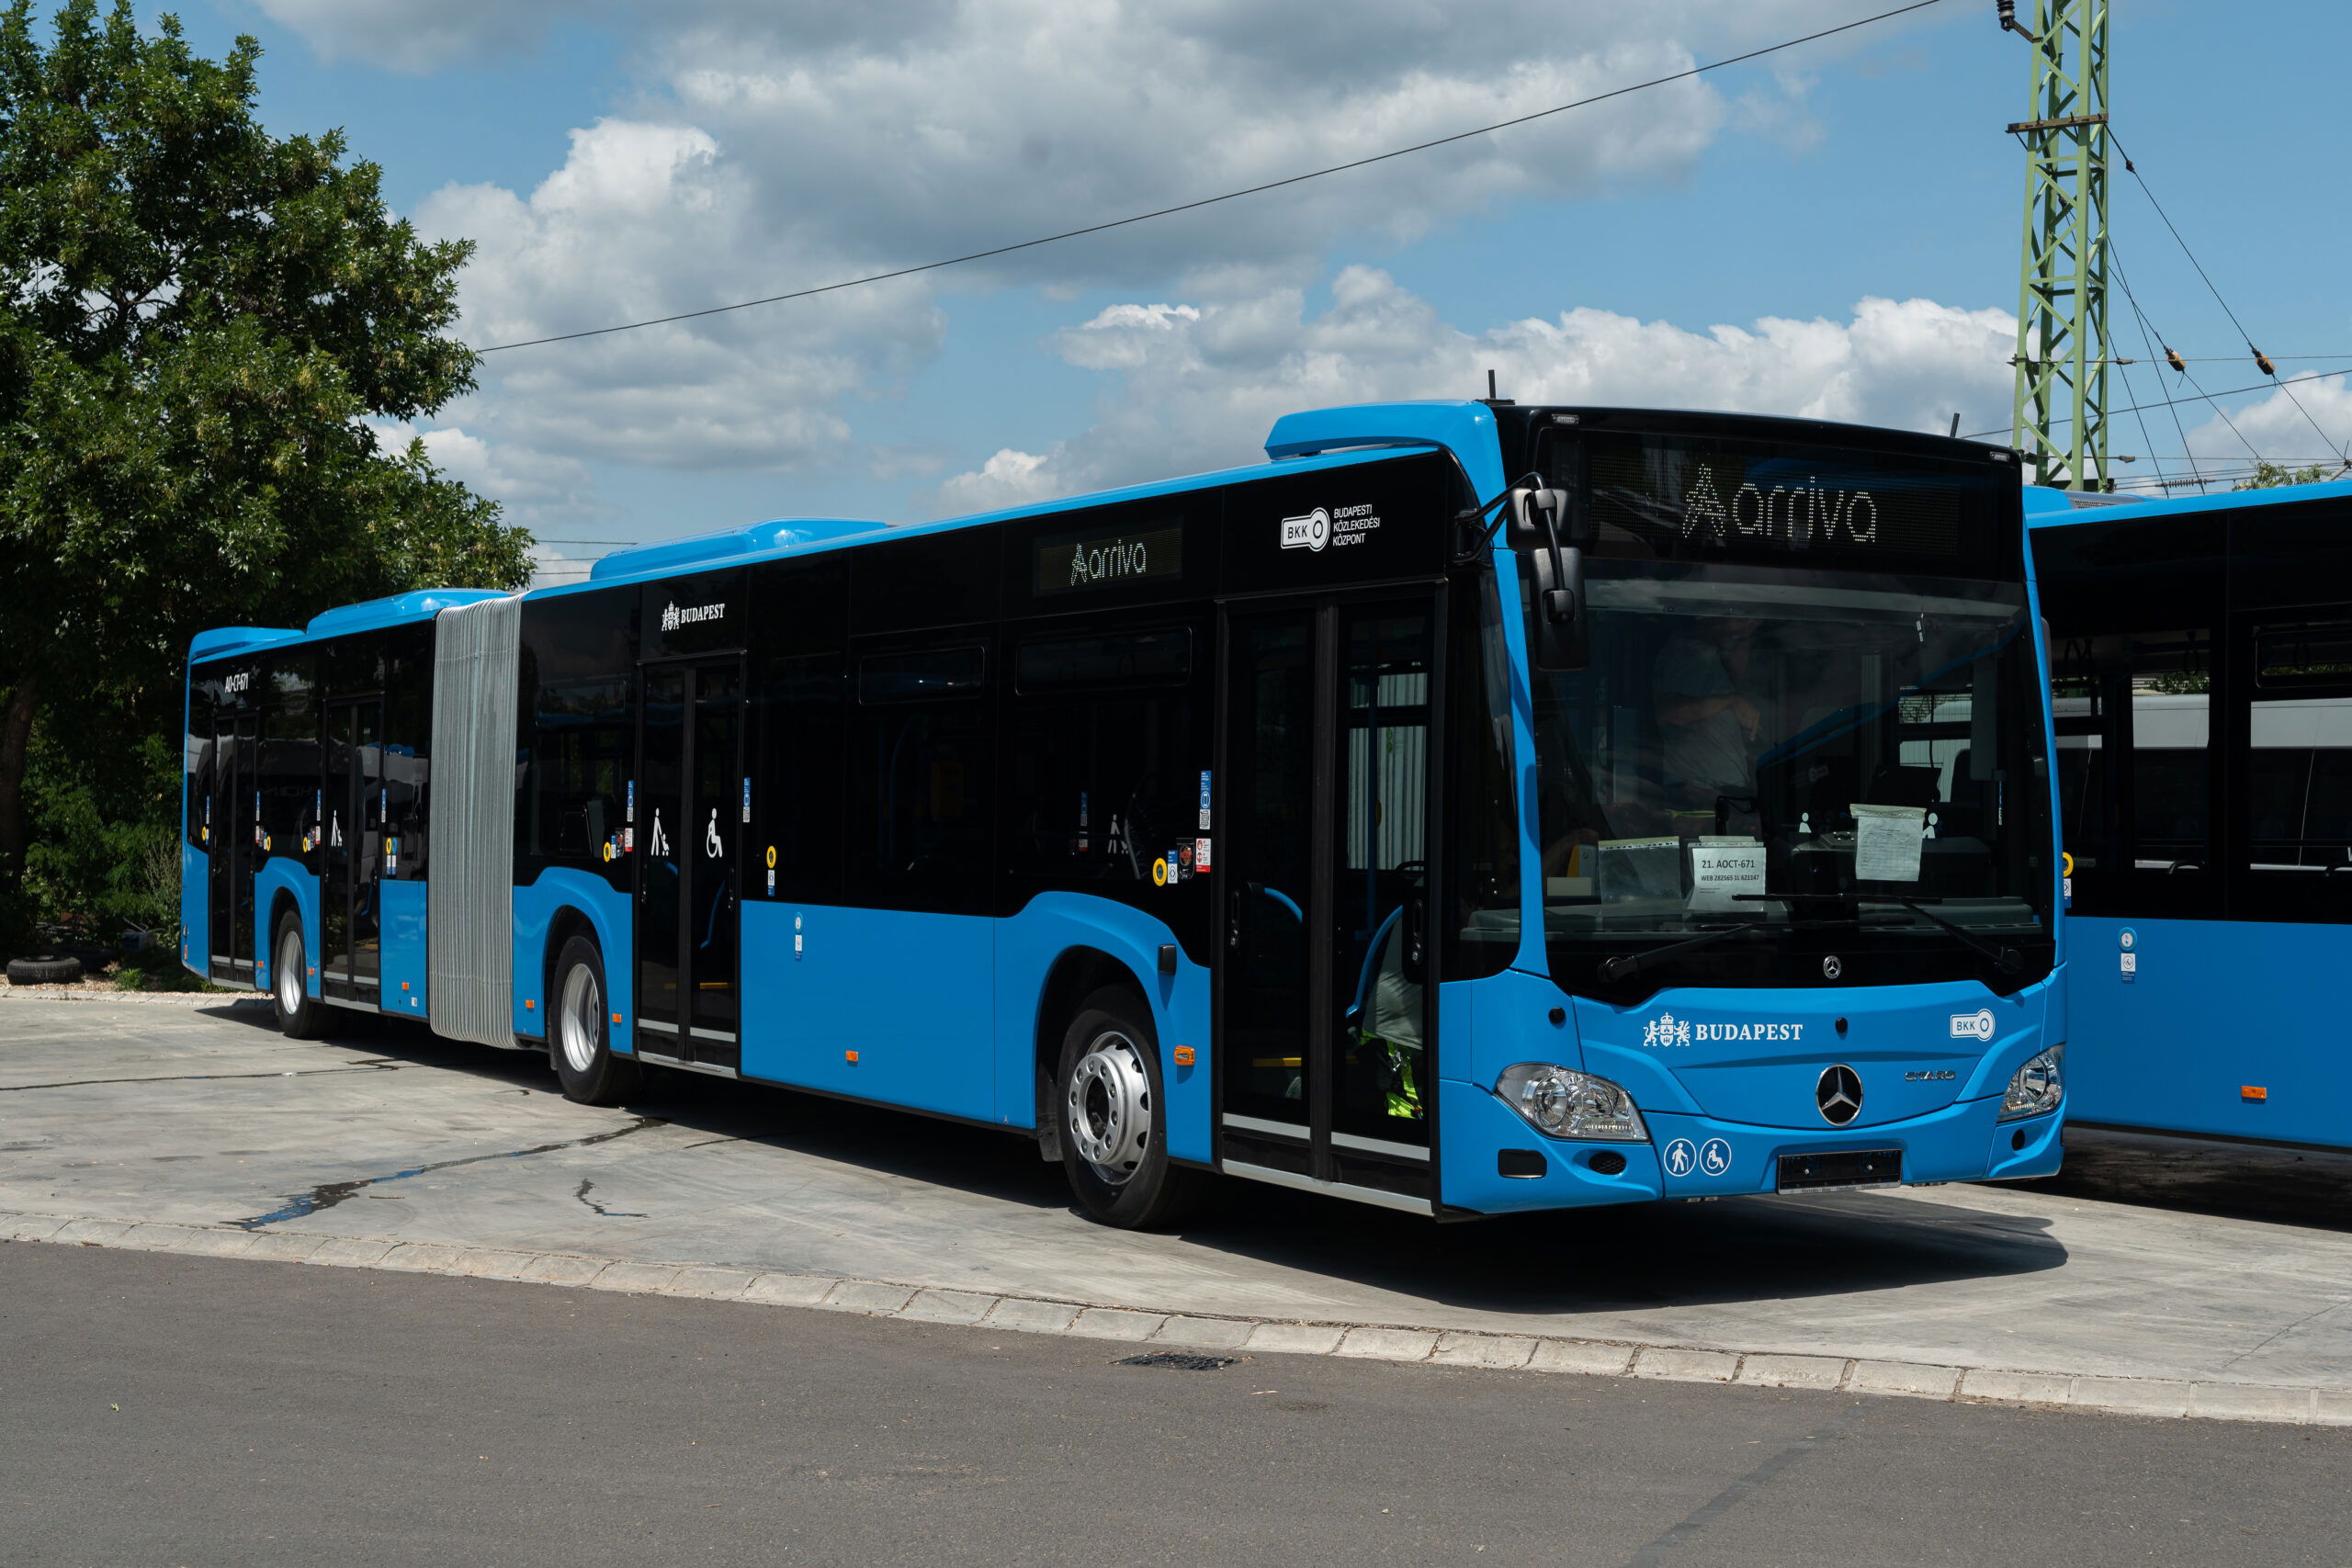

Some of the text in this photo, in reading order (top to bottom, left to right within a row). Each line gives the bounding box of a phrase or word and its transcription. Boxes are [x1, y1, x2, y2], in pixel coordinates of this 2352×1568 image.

[1333, 503, 1373, 519] BUDAPESTI
[1287, 525, 1308, 539] BKK
[1333, 516, 1381, 533] KÖZLEKEDÉSI
[1332, 533, 1366, 547] KÖZPONT
[681, 603, 725, 624] BUDAPEST
[1702, 859, 1756, 869] 21. AOCT-671
[1695, 1023, 1804, 1041] BUDAPEST
[1956, 1021, 1976, 1032] BKK
